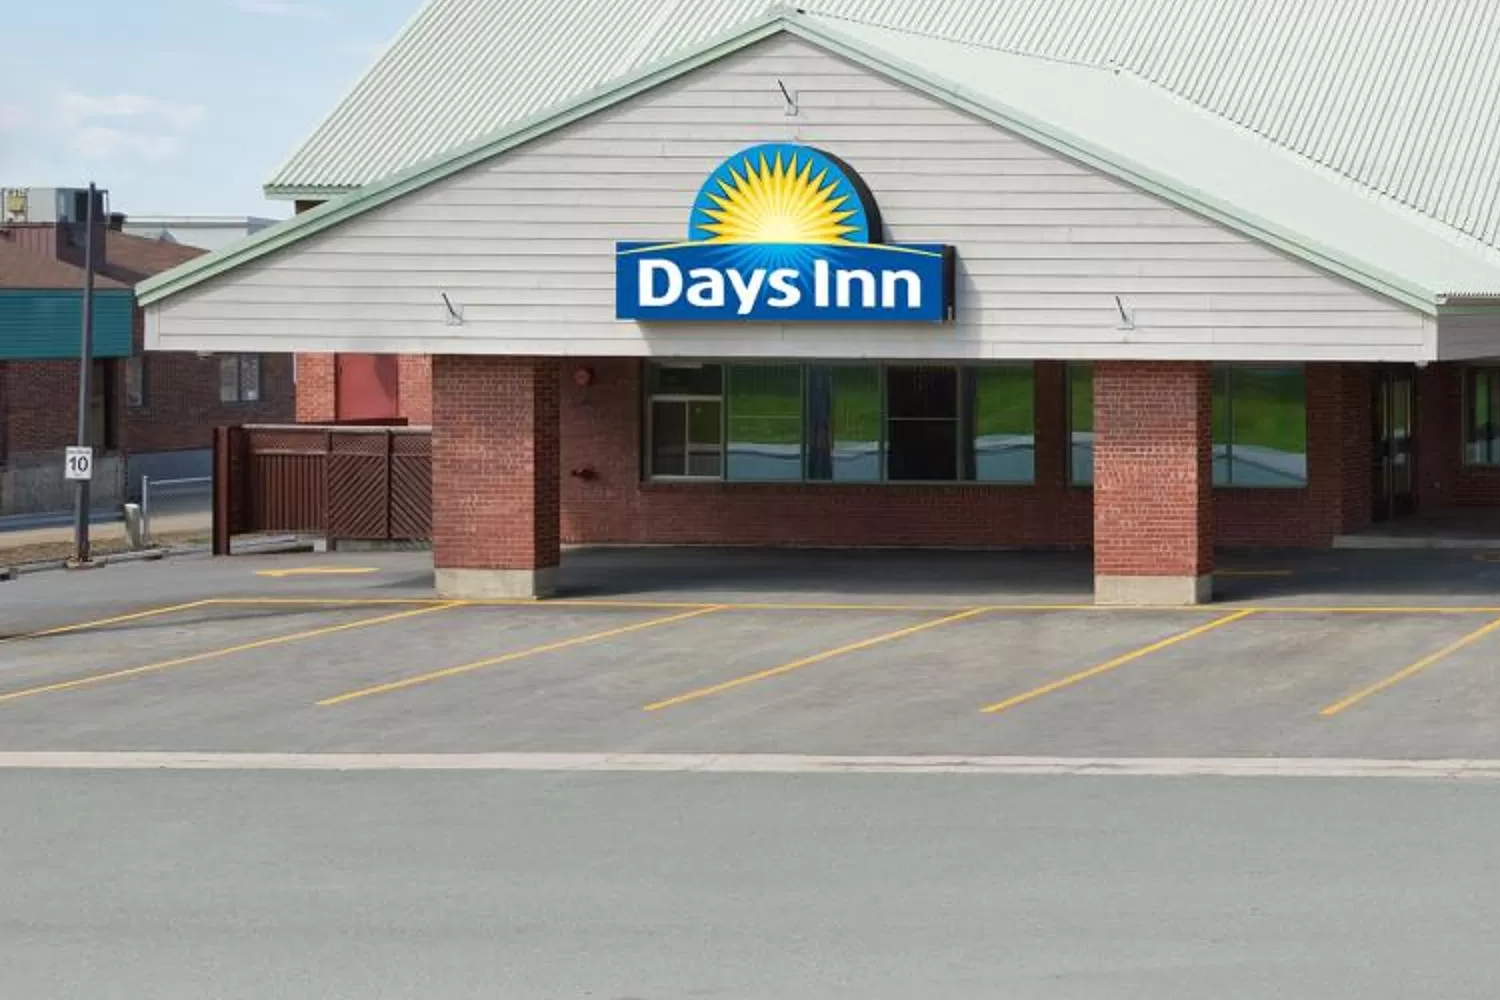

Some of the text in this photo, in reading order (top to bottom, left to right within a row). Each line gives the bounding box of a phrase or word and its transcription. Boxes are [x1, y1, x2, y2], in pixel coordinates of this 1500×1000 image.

[638, 259, 921, 315] Days Inn
[69, 456, 89, 472] 10
